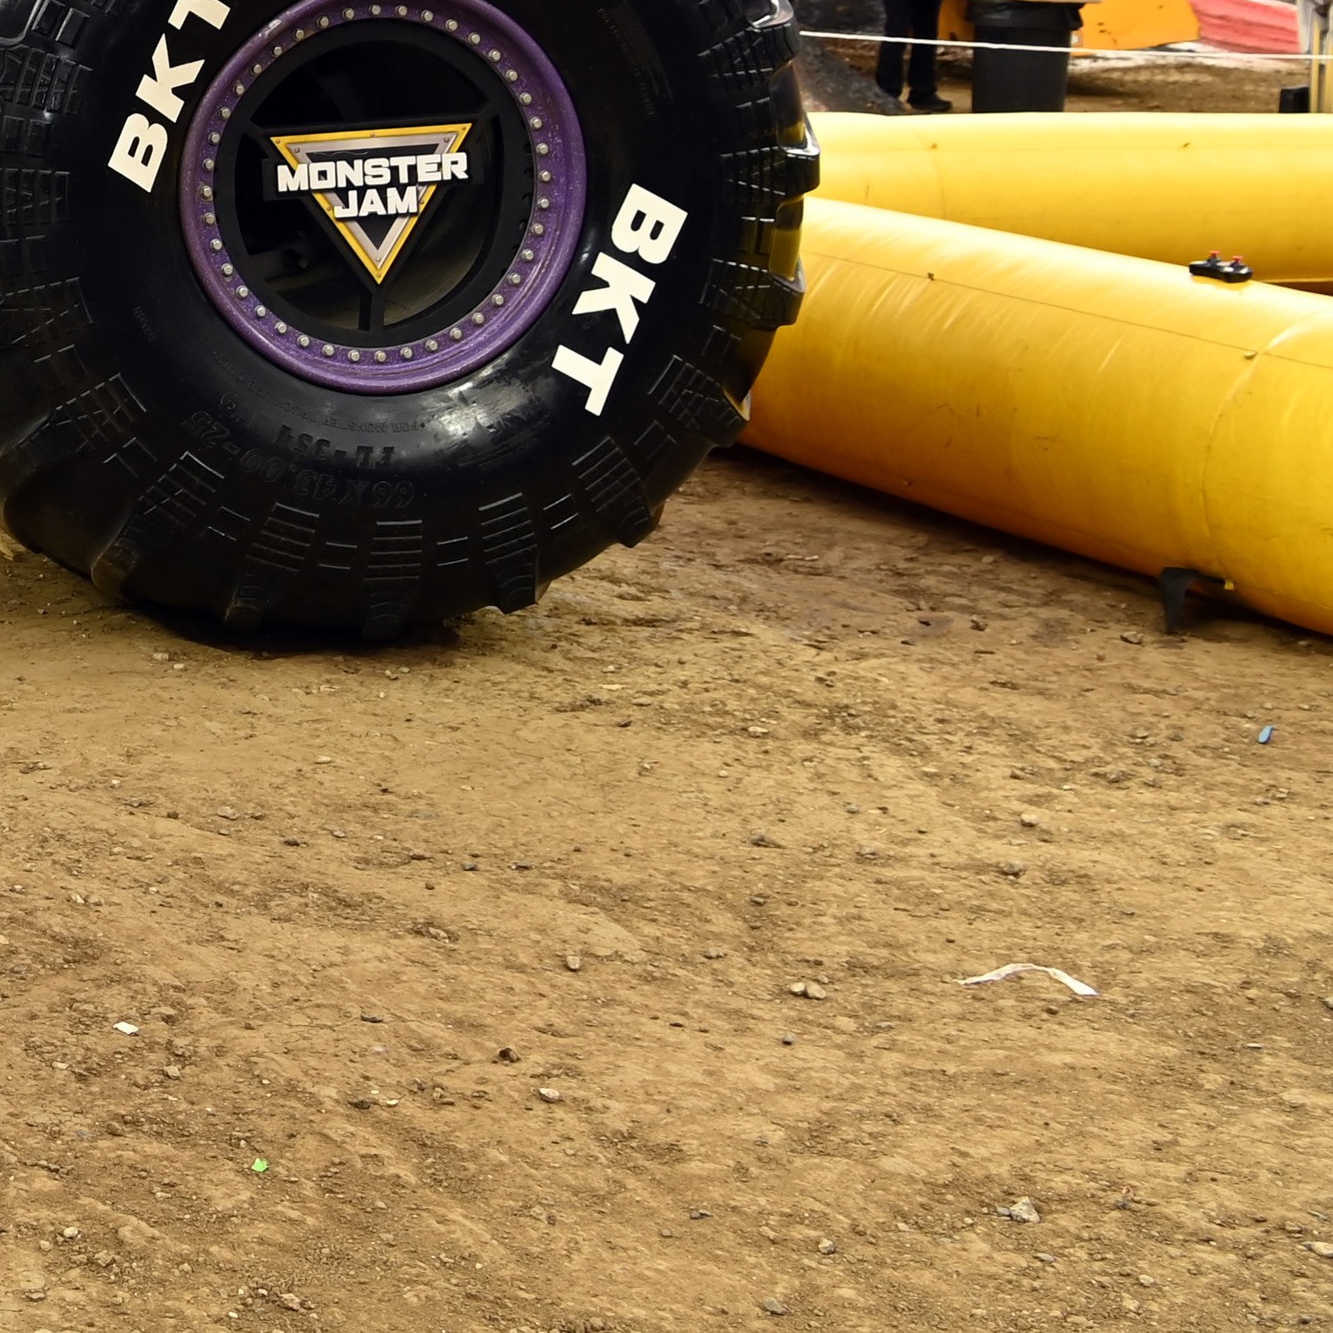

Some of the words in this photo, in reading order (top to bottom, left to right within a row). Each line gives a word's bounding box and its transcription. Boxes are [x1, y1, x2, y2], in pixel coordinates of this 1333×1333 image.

[277, 152, 468, 192] MONSTER
[333, 186, 419, 220] JAM
[551, 183, 687, 416] BKT
